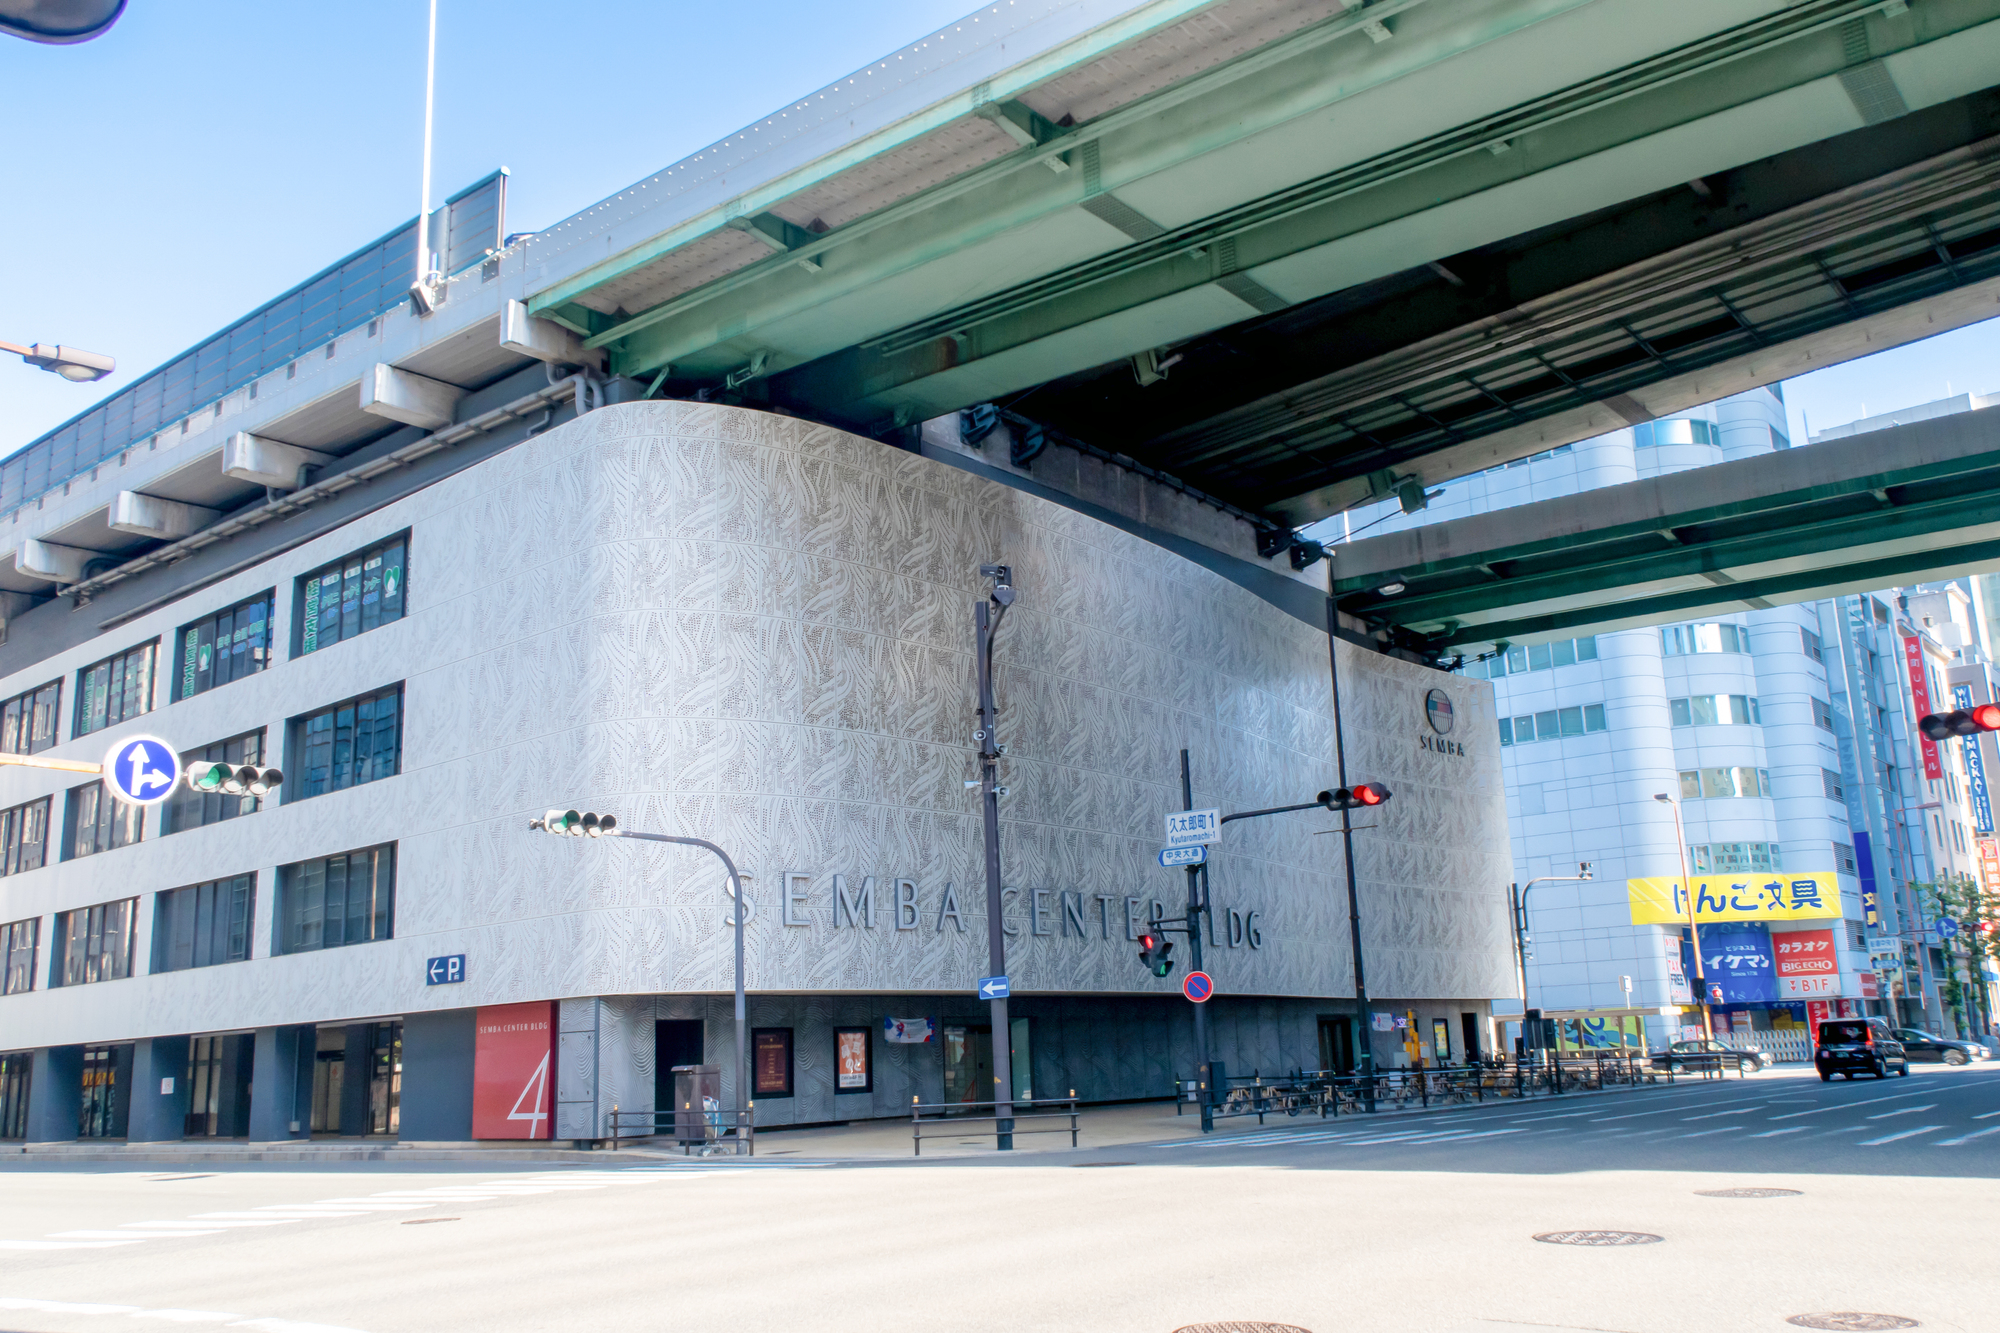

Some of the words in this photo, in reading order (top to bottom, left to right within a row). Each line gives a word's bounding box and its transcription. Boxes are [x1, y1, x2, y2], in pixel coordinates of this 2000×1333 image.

[1908, 643, 1938, 772] 本町UNIビル
[1420, 735, 1465, 757] SEMBA
[1966, 741, 1983, 795] MACKAY
[1170, 830, 1216, 845] Kyutaromachi-1
[1166, 848, 1199, 860] 中央大通
[724, 870, 966, 932] SEMBA
[1001, 886, 1167, 942] CENTER
[1190, 901, 1263, 950] LDG
[1863, 892, 1878, 926] 文具
[1779, 940, 1829, 954] カラオケ
[447, 957, 461, 982] P
[1668, 960, 1680, 972] TAX
[1706, 953, 1769, 970] イケマン
[1782, 961, 1801, 972] BIG
[1803, 959, 1833, 971] ECHO
[1801, 978, 1830, 992] B1F
[479, 1026, 502, 1034] SEMBA
[503, 1023, 528, 1033] CENTER
[530, 1021, 548, 1031] BLDG
[506, 1048, 550, 1139] 4
